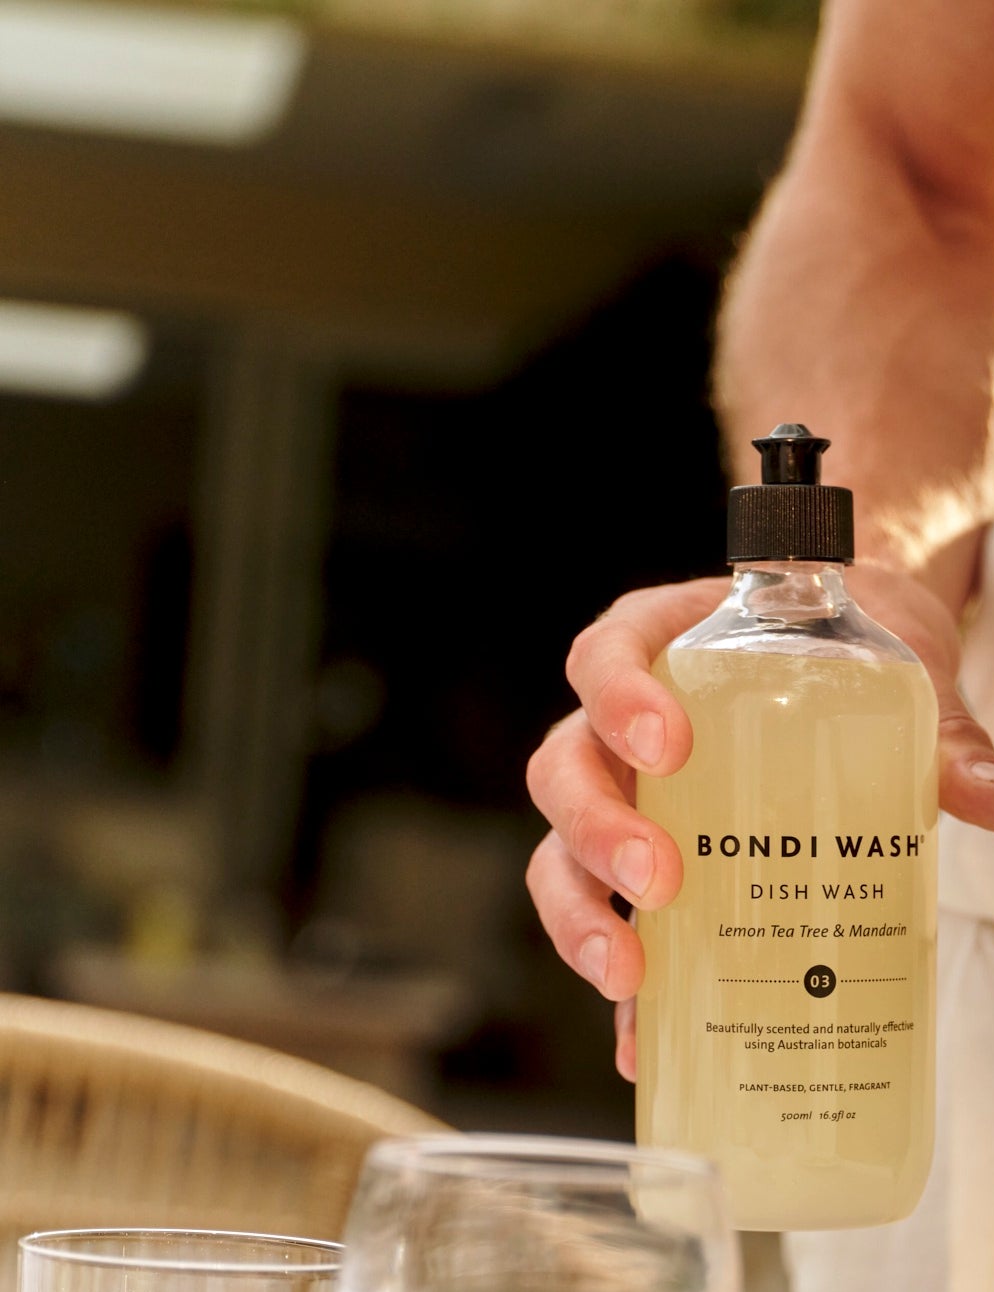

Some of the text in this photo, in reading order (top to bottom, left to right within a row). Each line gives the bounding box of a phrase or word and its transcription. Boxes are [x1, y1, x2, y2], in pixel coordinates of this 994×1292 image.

[697, 834, 817, 858] BONDI
[750, 883, 884, 900] DISH WASH
[718, 922, 907, 938] Lemon Tea Tree & Mandarin
[809, 974, 831, 989] 03
[705, 1020, 914, 1037] Beautifully scented and naturally effective
[744, 1037, 888, 1053] using Australian botanicals
[738, 1081, 891, 1094] PLANT-BASED, GENTLE, FRAGRANT
[780, 1110, 813, 1122] 500ml
[846, 1111, 857, 1120] oz
